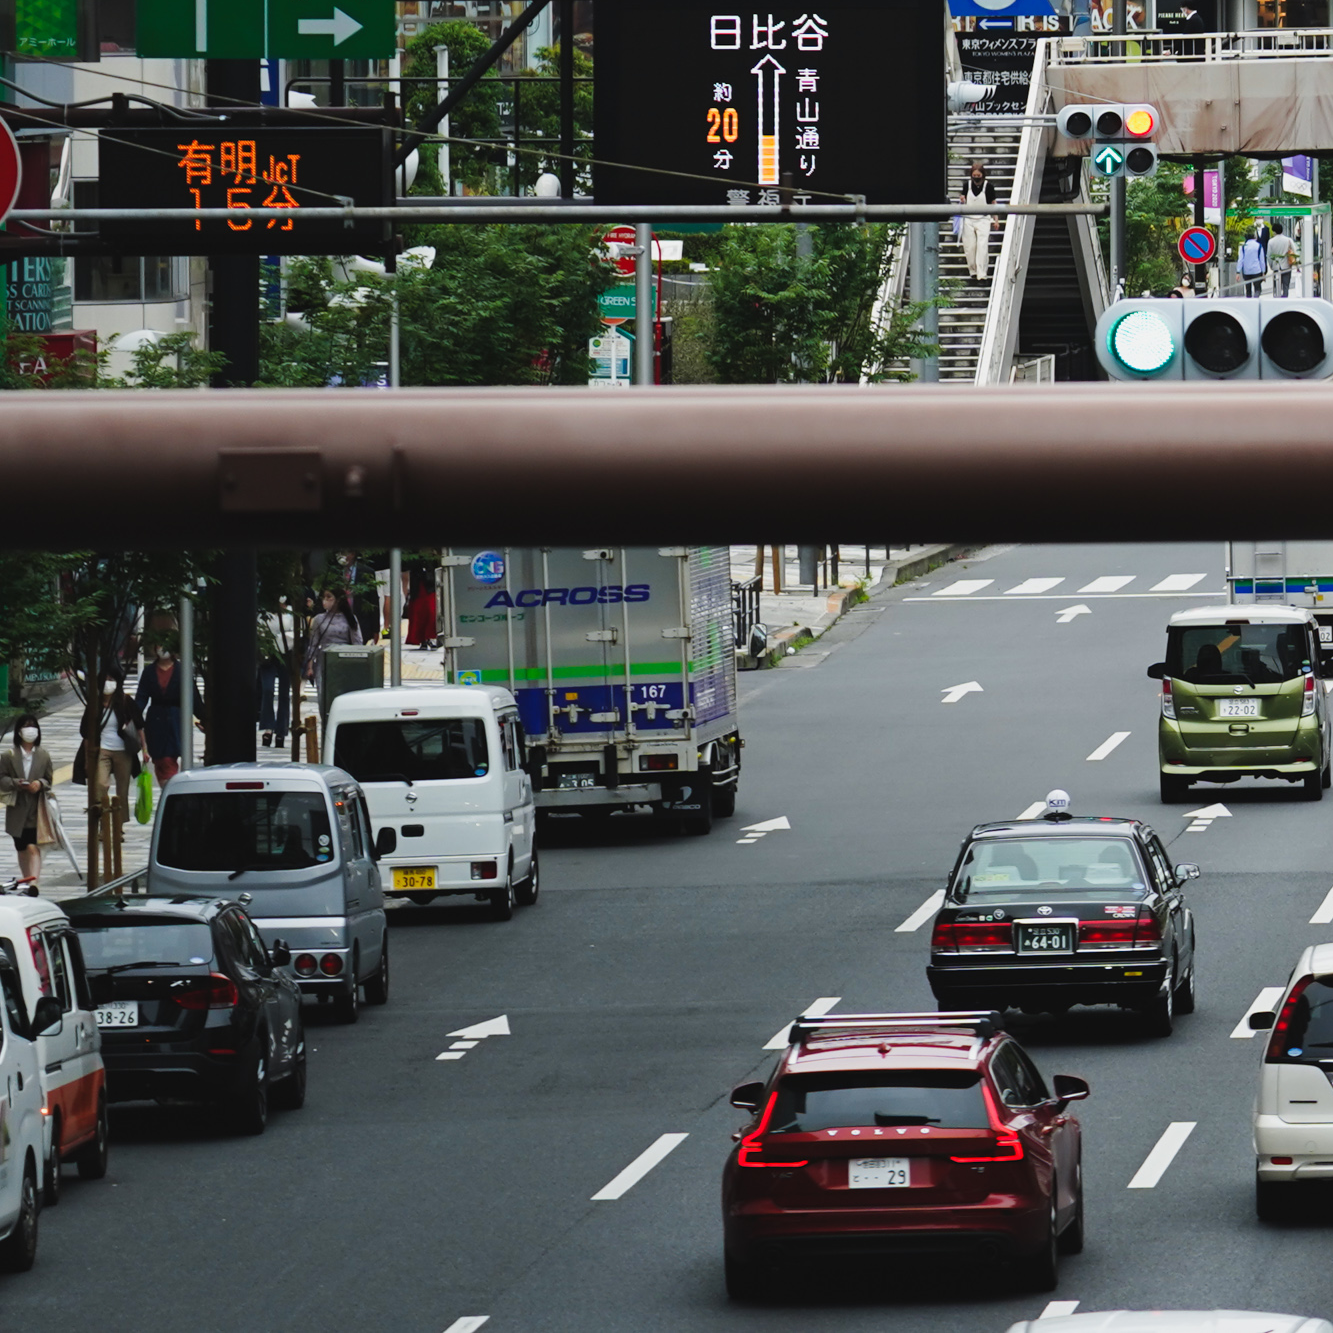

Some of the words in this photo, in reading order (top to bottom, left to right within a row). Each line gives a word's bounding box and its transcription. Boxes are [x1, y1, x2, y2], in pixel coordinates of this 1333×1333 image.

[710, 14, 829, 51] 日比谷
[18, 37, 76, 48] アミーホール
[969, 101, 1027, 112] 山ブックセン
[795, 68, 820, 176] 青山通り
[601, 296, 630, 306] GREEN
[484, 583, 651, 609] ACROSS
[641, 685, 666, 699] 167
[1228, 704, 1256, 716] 22-02
[403, 875, 433, 887] 30-78
[1031, 935, 1067, 949] 64-01
[98, 1012, 136, 1025] 38-26
[827, 1126, 932, 1137] VOLVO
